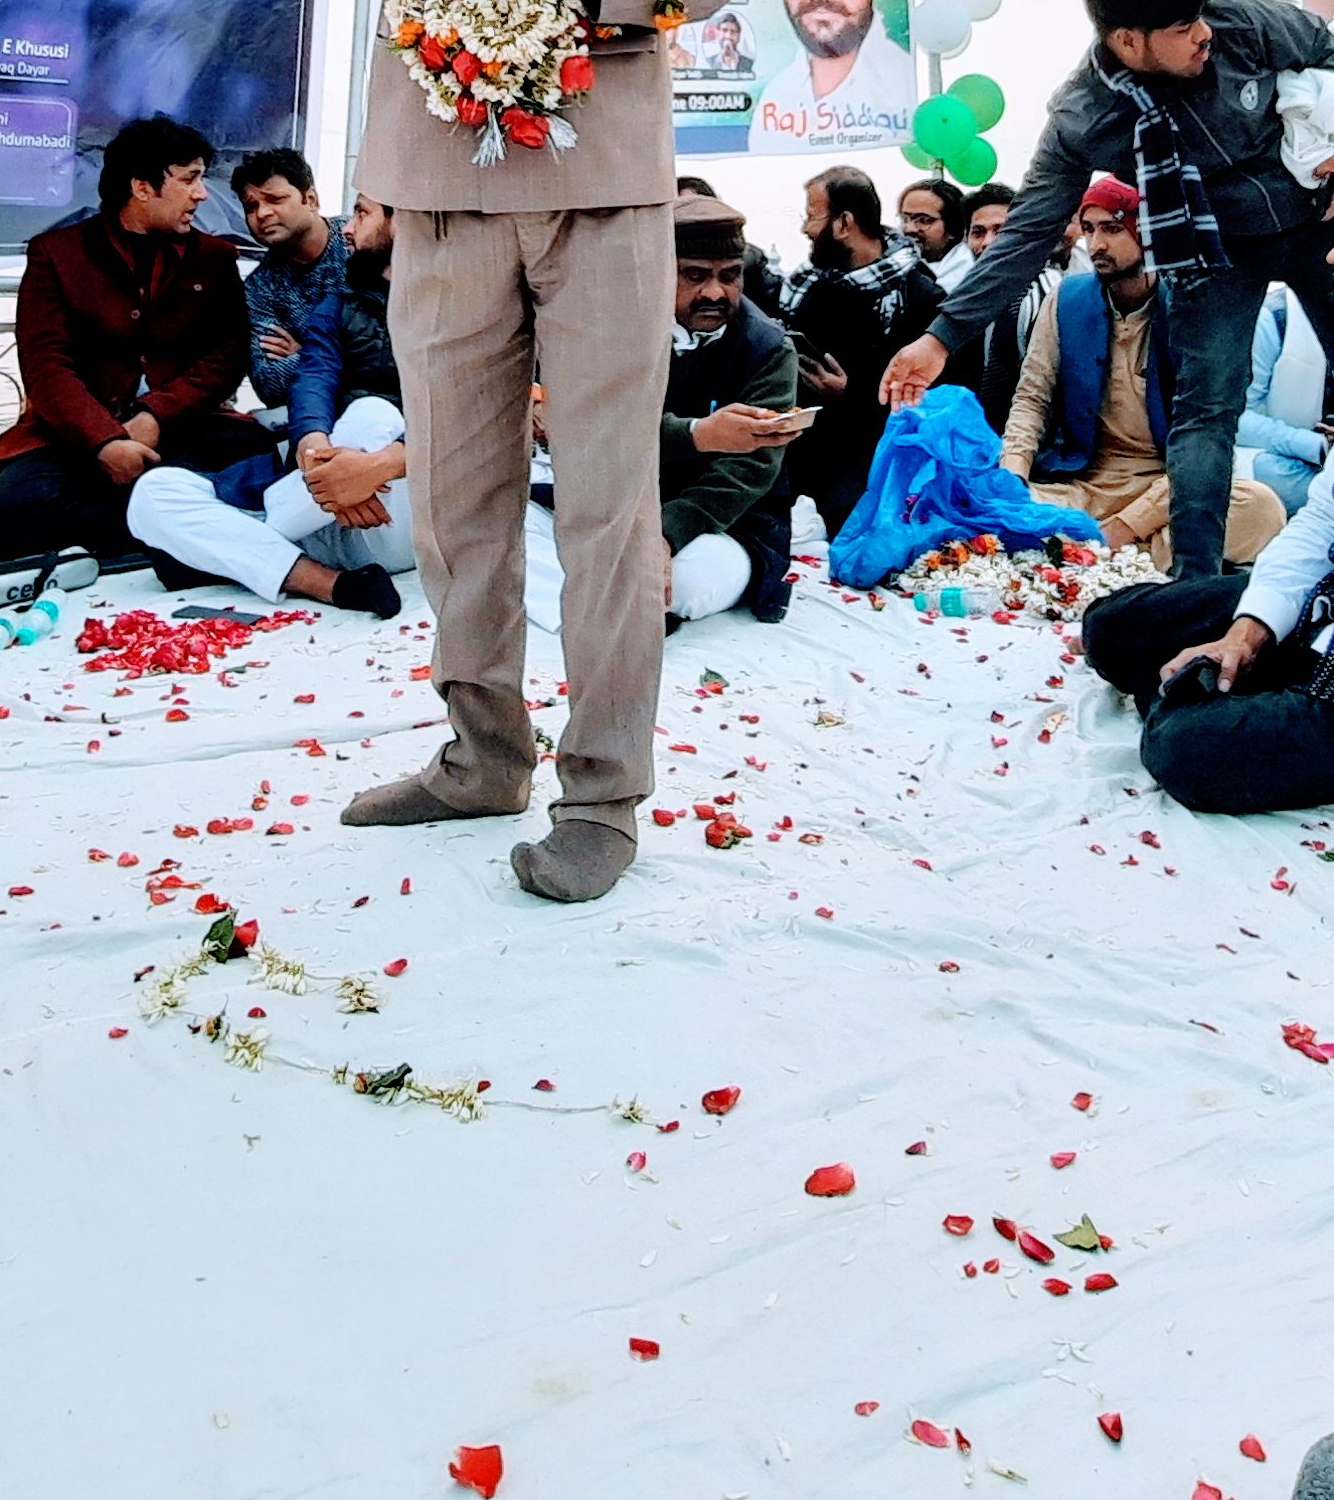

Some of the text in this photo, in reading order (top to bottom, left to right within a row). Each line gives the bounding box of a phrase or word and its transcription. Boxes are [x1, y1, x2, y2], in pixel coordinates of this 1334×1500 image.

[3, 38, 13, 54] E
[16, 40, 70, 59] Khususi
[18, 62, 50, 78] Dayar
[688, 94, 745, 111] 09:00AM
[762, 101, 808, 138] Raj
